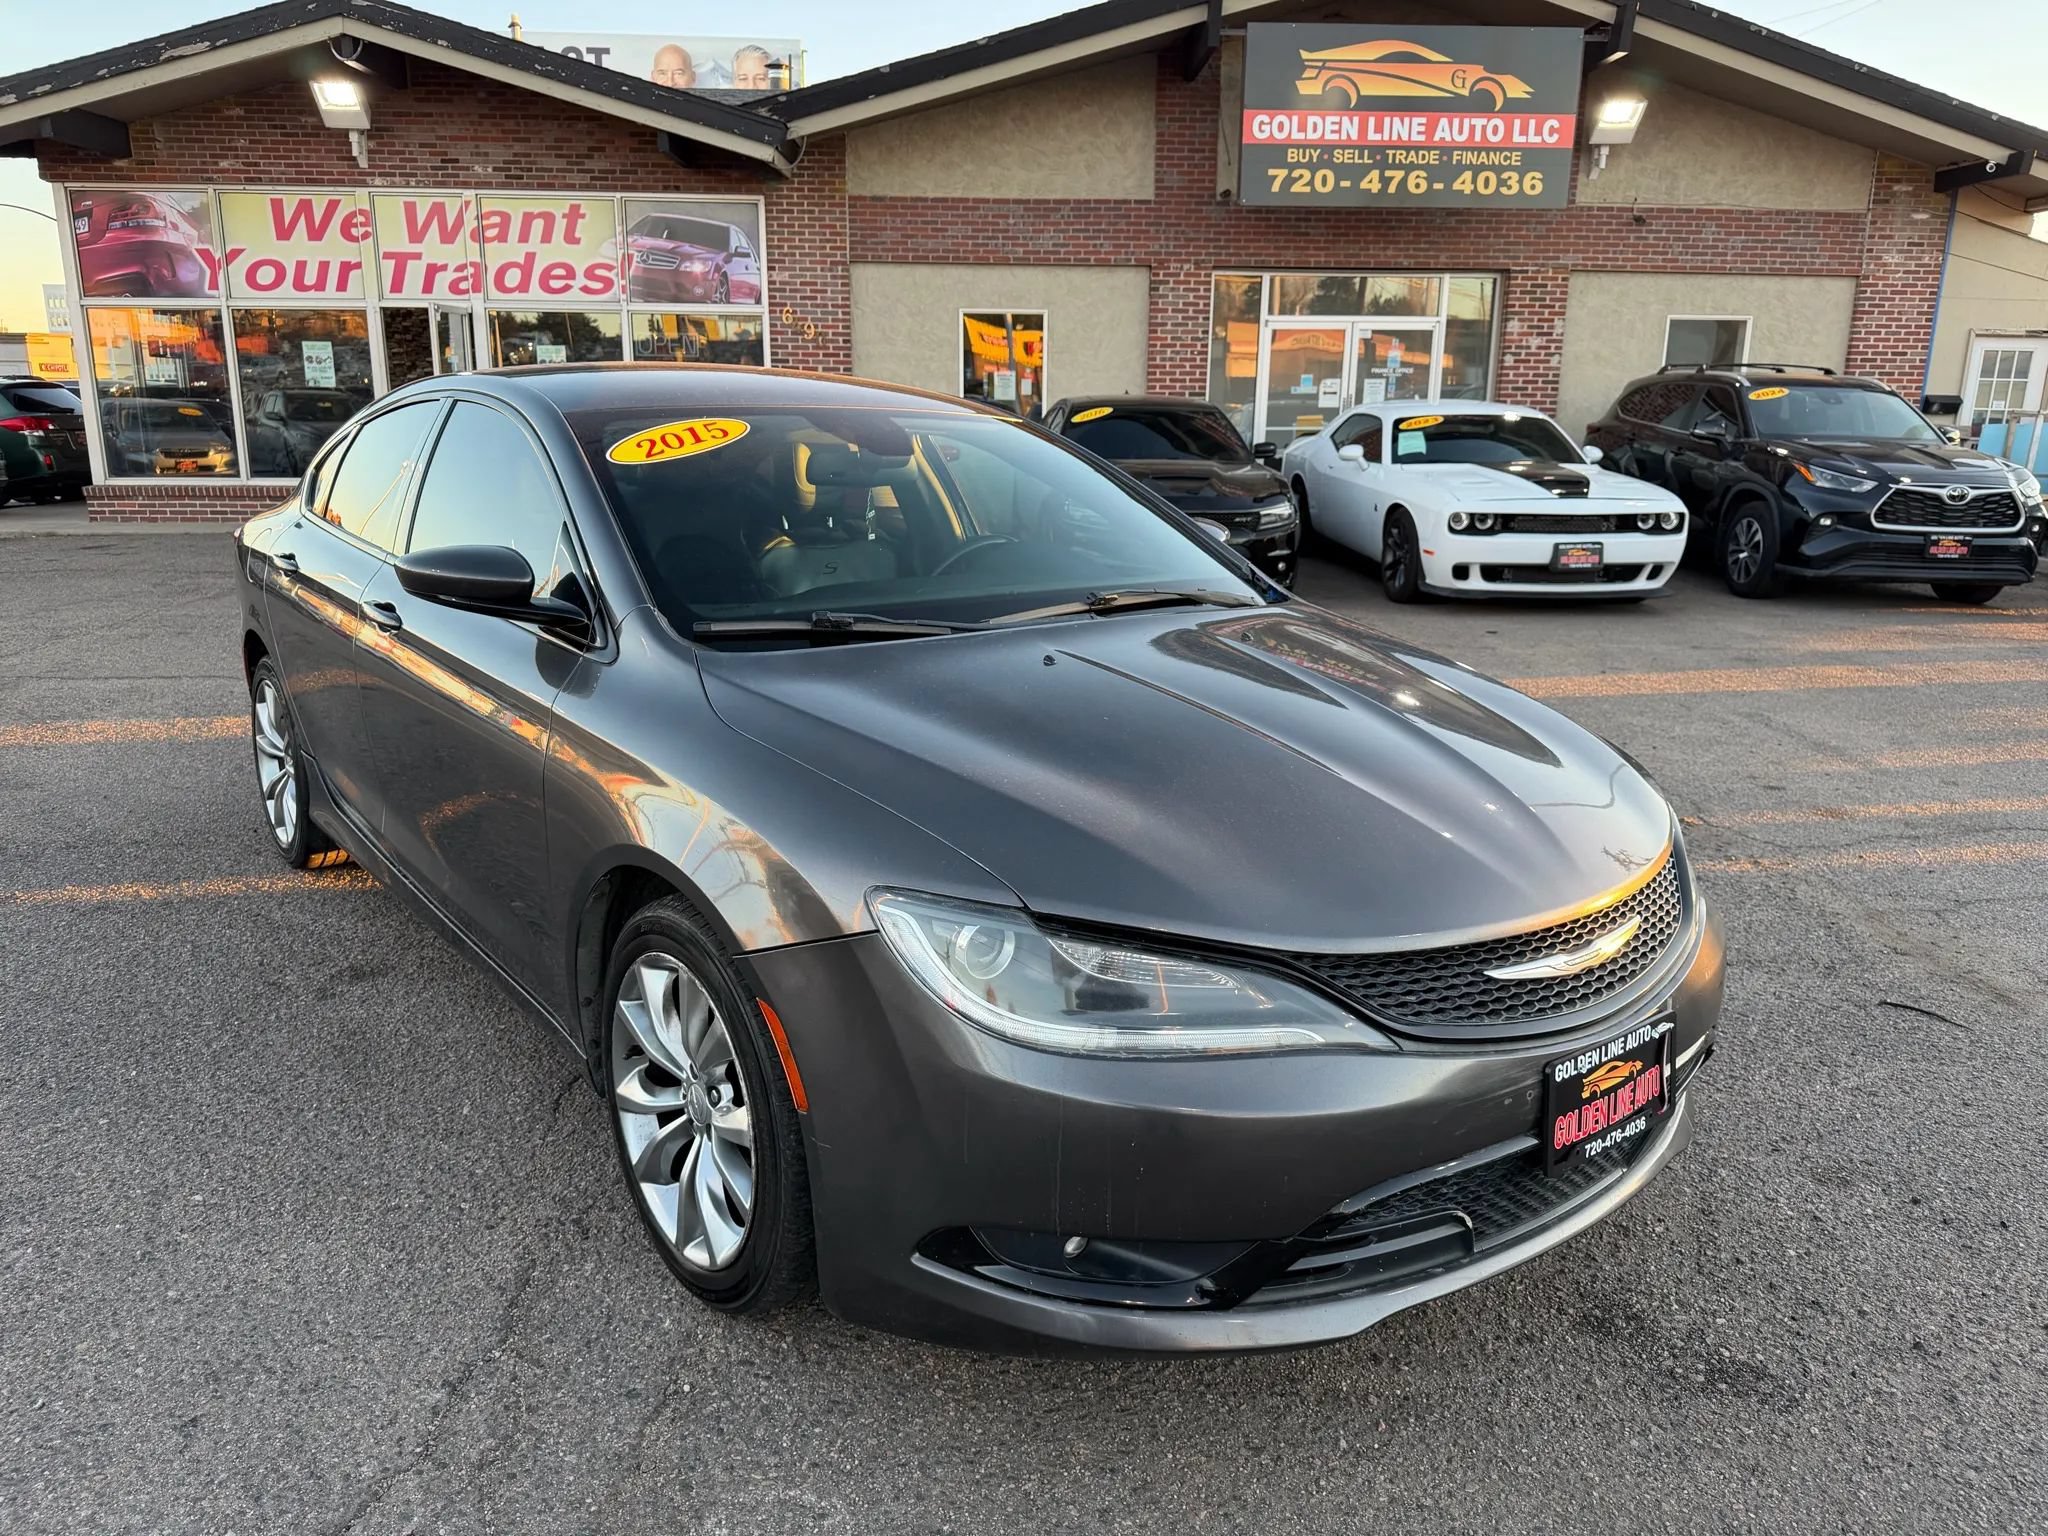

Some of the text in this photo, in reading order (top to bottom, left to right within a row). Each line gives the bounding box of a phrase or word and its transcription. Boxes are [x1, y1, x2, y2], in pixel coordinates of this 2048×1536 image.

[1252, 114, 1560, 144] GOLDEN LINE AUTO LLC
[1287, 148, 1522, 165] BUY SELL TRADE FINANCE
[270, 197, 587, 245] We Want
[195, 247, 637, 296] Your Trades!
[639, 335, 697, 354] OPEN
[635, 421, 730, 459] 2015
[1555, 1024, 1652, 1082] GOLDEN LINE AUTO
[1554, 1064, 1661, 1149] GOLDEN LINE AUTO
[1585, 1116, 1646, 1158] 720-476-4036
